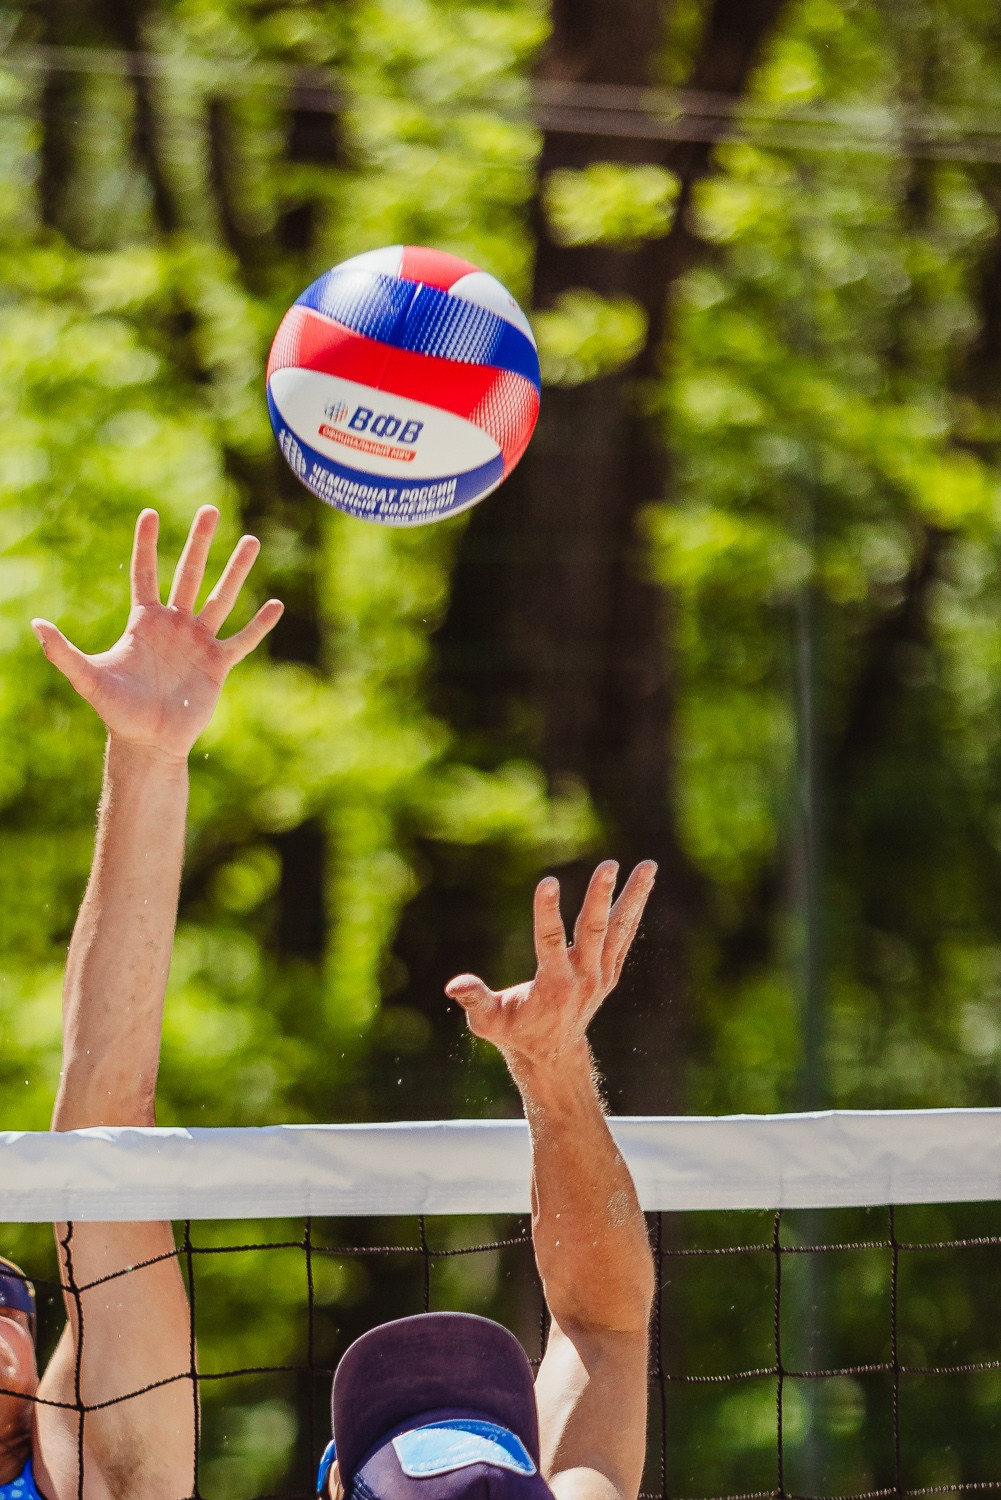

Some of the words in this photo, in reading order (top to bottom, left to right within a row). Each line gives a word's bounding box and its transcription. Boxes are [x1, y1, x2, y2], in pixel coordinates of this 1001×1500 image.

[348, 406, 424, 443] ВФВ
[313, 463, 397, 503] ЧЕМПИОНАТ
[399, 478, 457, 503] РОССИИ
